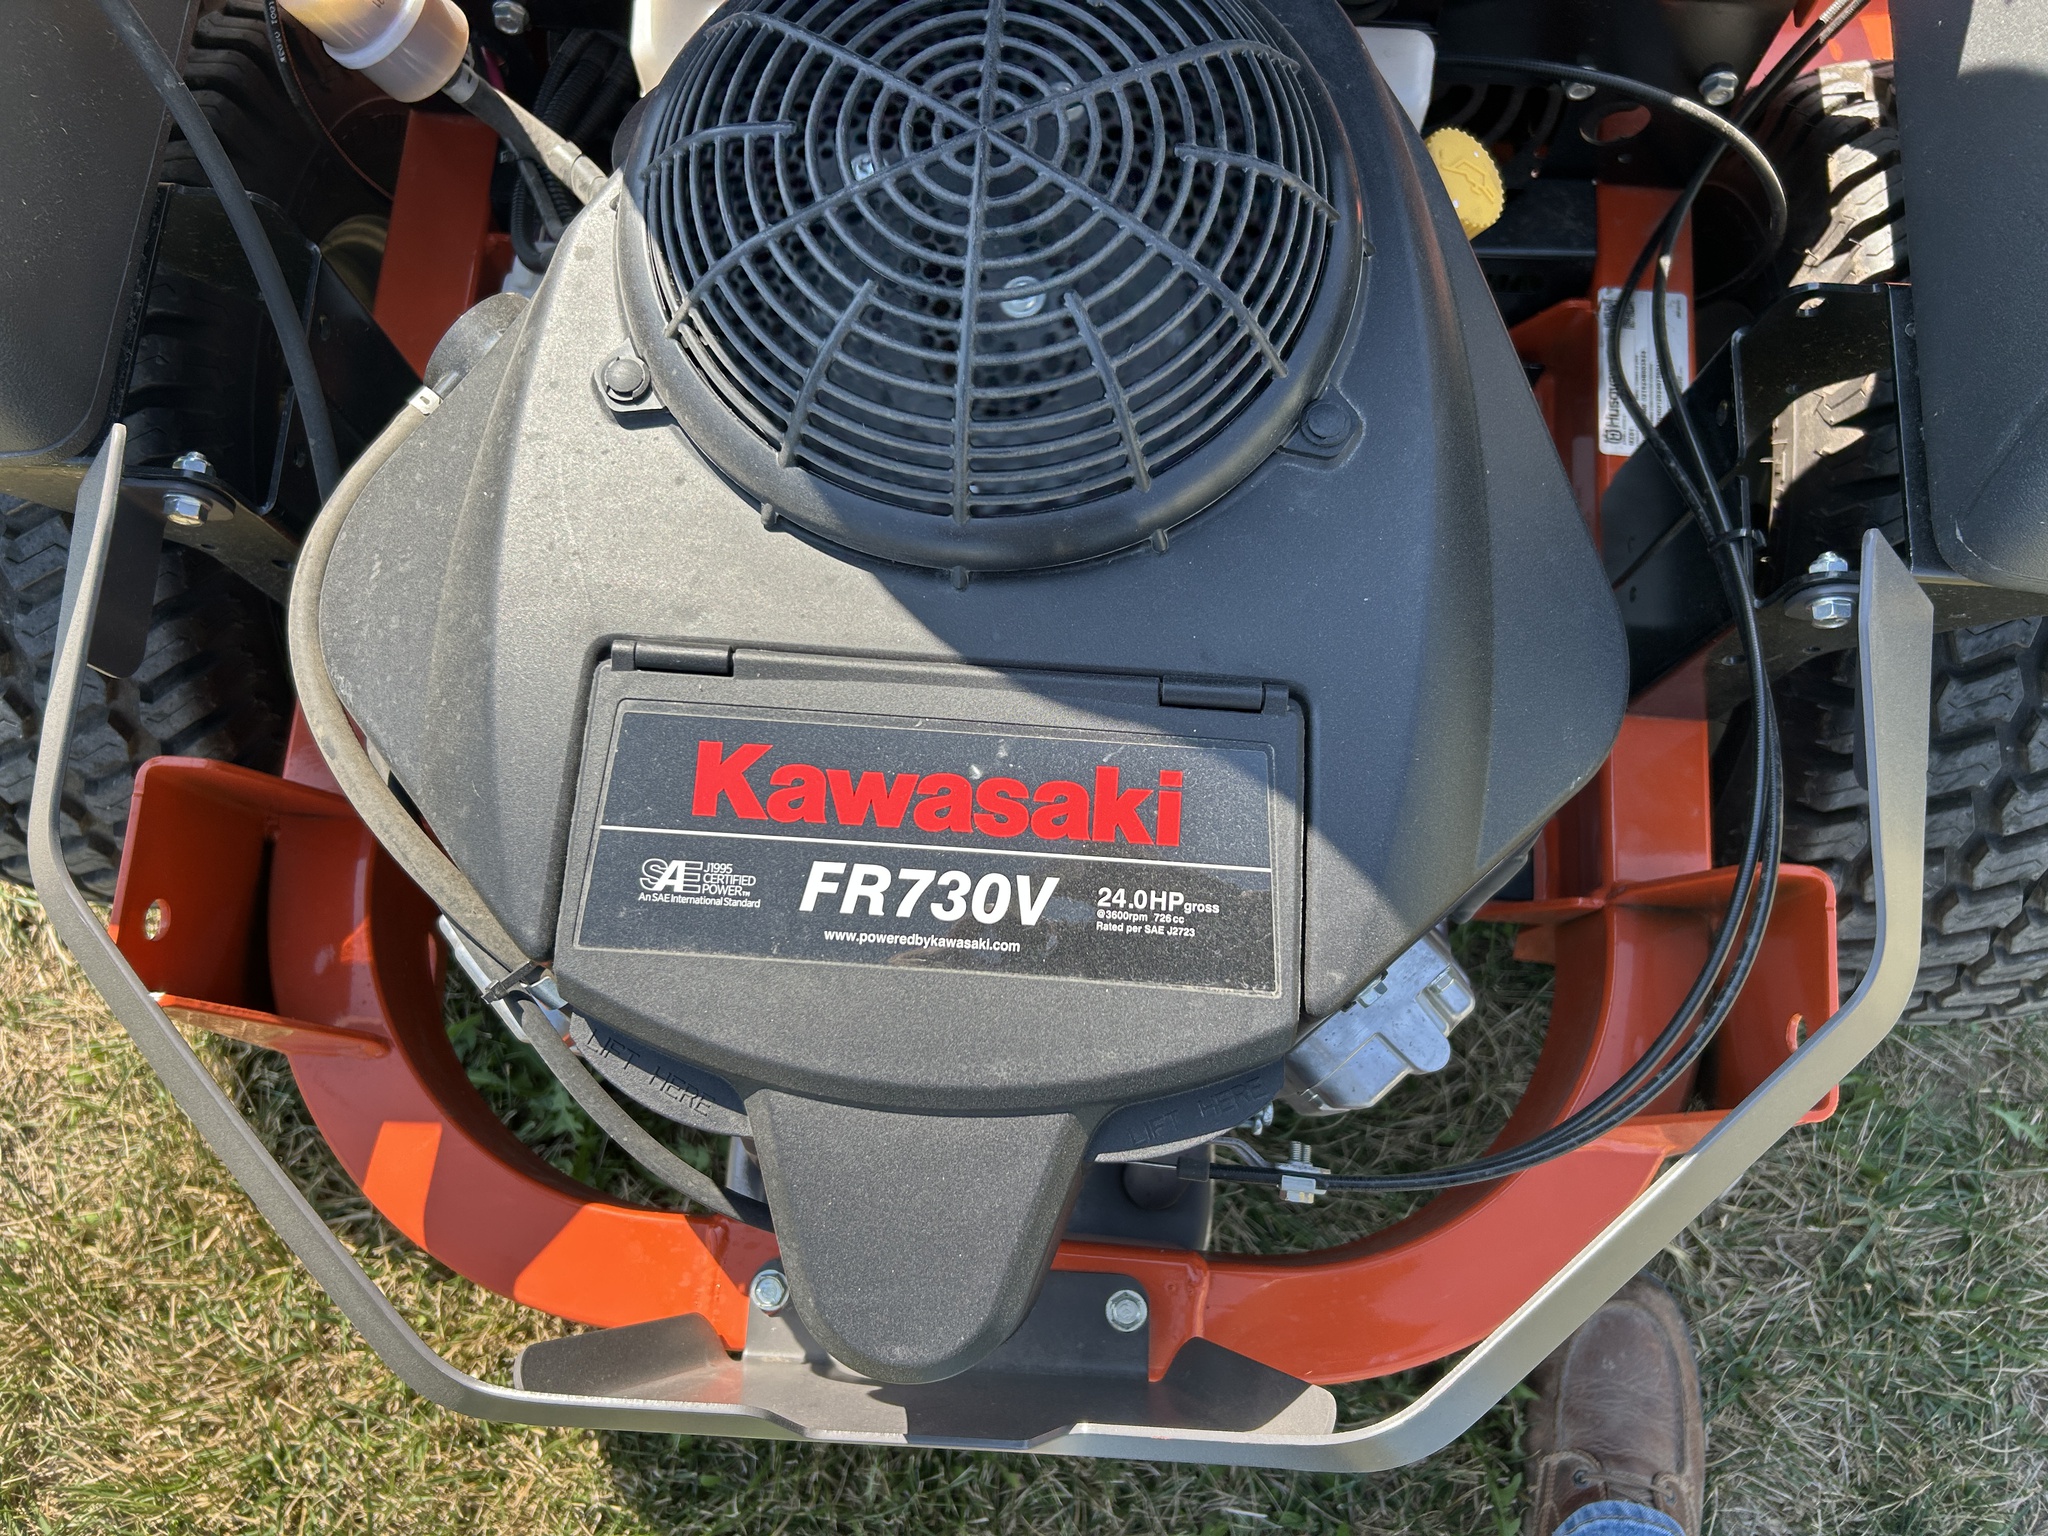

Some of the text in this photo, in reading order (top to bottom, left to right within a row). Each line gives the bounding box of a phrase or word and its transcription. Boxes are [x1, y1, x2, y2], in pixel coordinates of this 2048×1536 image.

[691, 740, 1183, 846] Kawasaki
[640, 858, 703, 894] SAE
[703, 862, 733, 874] J1995
[703, 873, 757, 886] CERTIFIED
[638, 892, 761, 908] An SAE International Standard
[799, 860, 1061, 926] FR730V
[1096, 909, 1148, 922] @3600rpm
[1096, 921, 1196, 937] Rated per SAE J2723
[824, 930, 1021, 953] www.poweredbykawasaki.com
[586, 1028, 716, 1117] LIFT HERE
[1128, 1076, 1268, 1146] LIFT HERE
